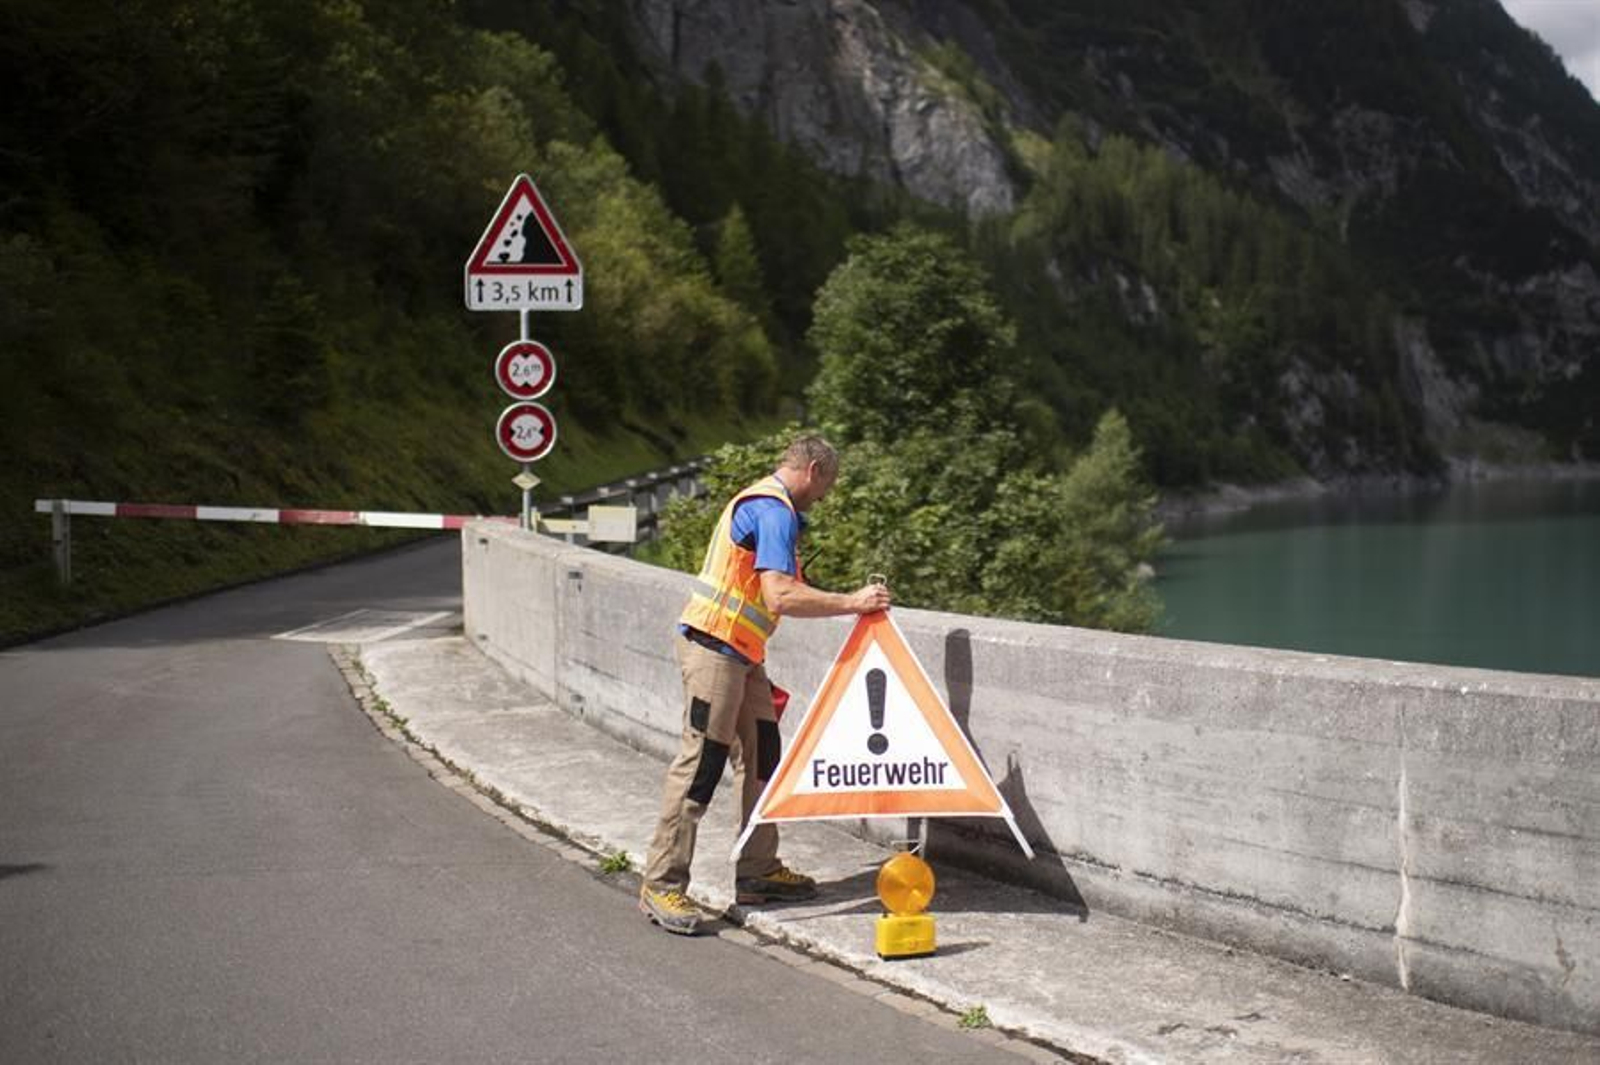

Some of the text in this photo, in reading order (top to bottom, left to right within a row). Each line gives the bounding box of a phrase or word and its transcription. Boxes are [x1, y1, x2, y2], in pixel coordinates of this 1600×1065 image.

[491, 280, 559, 304] 3,5 km
[813, 756, 948, 788] Feuerwehr
